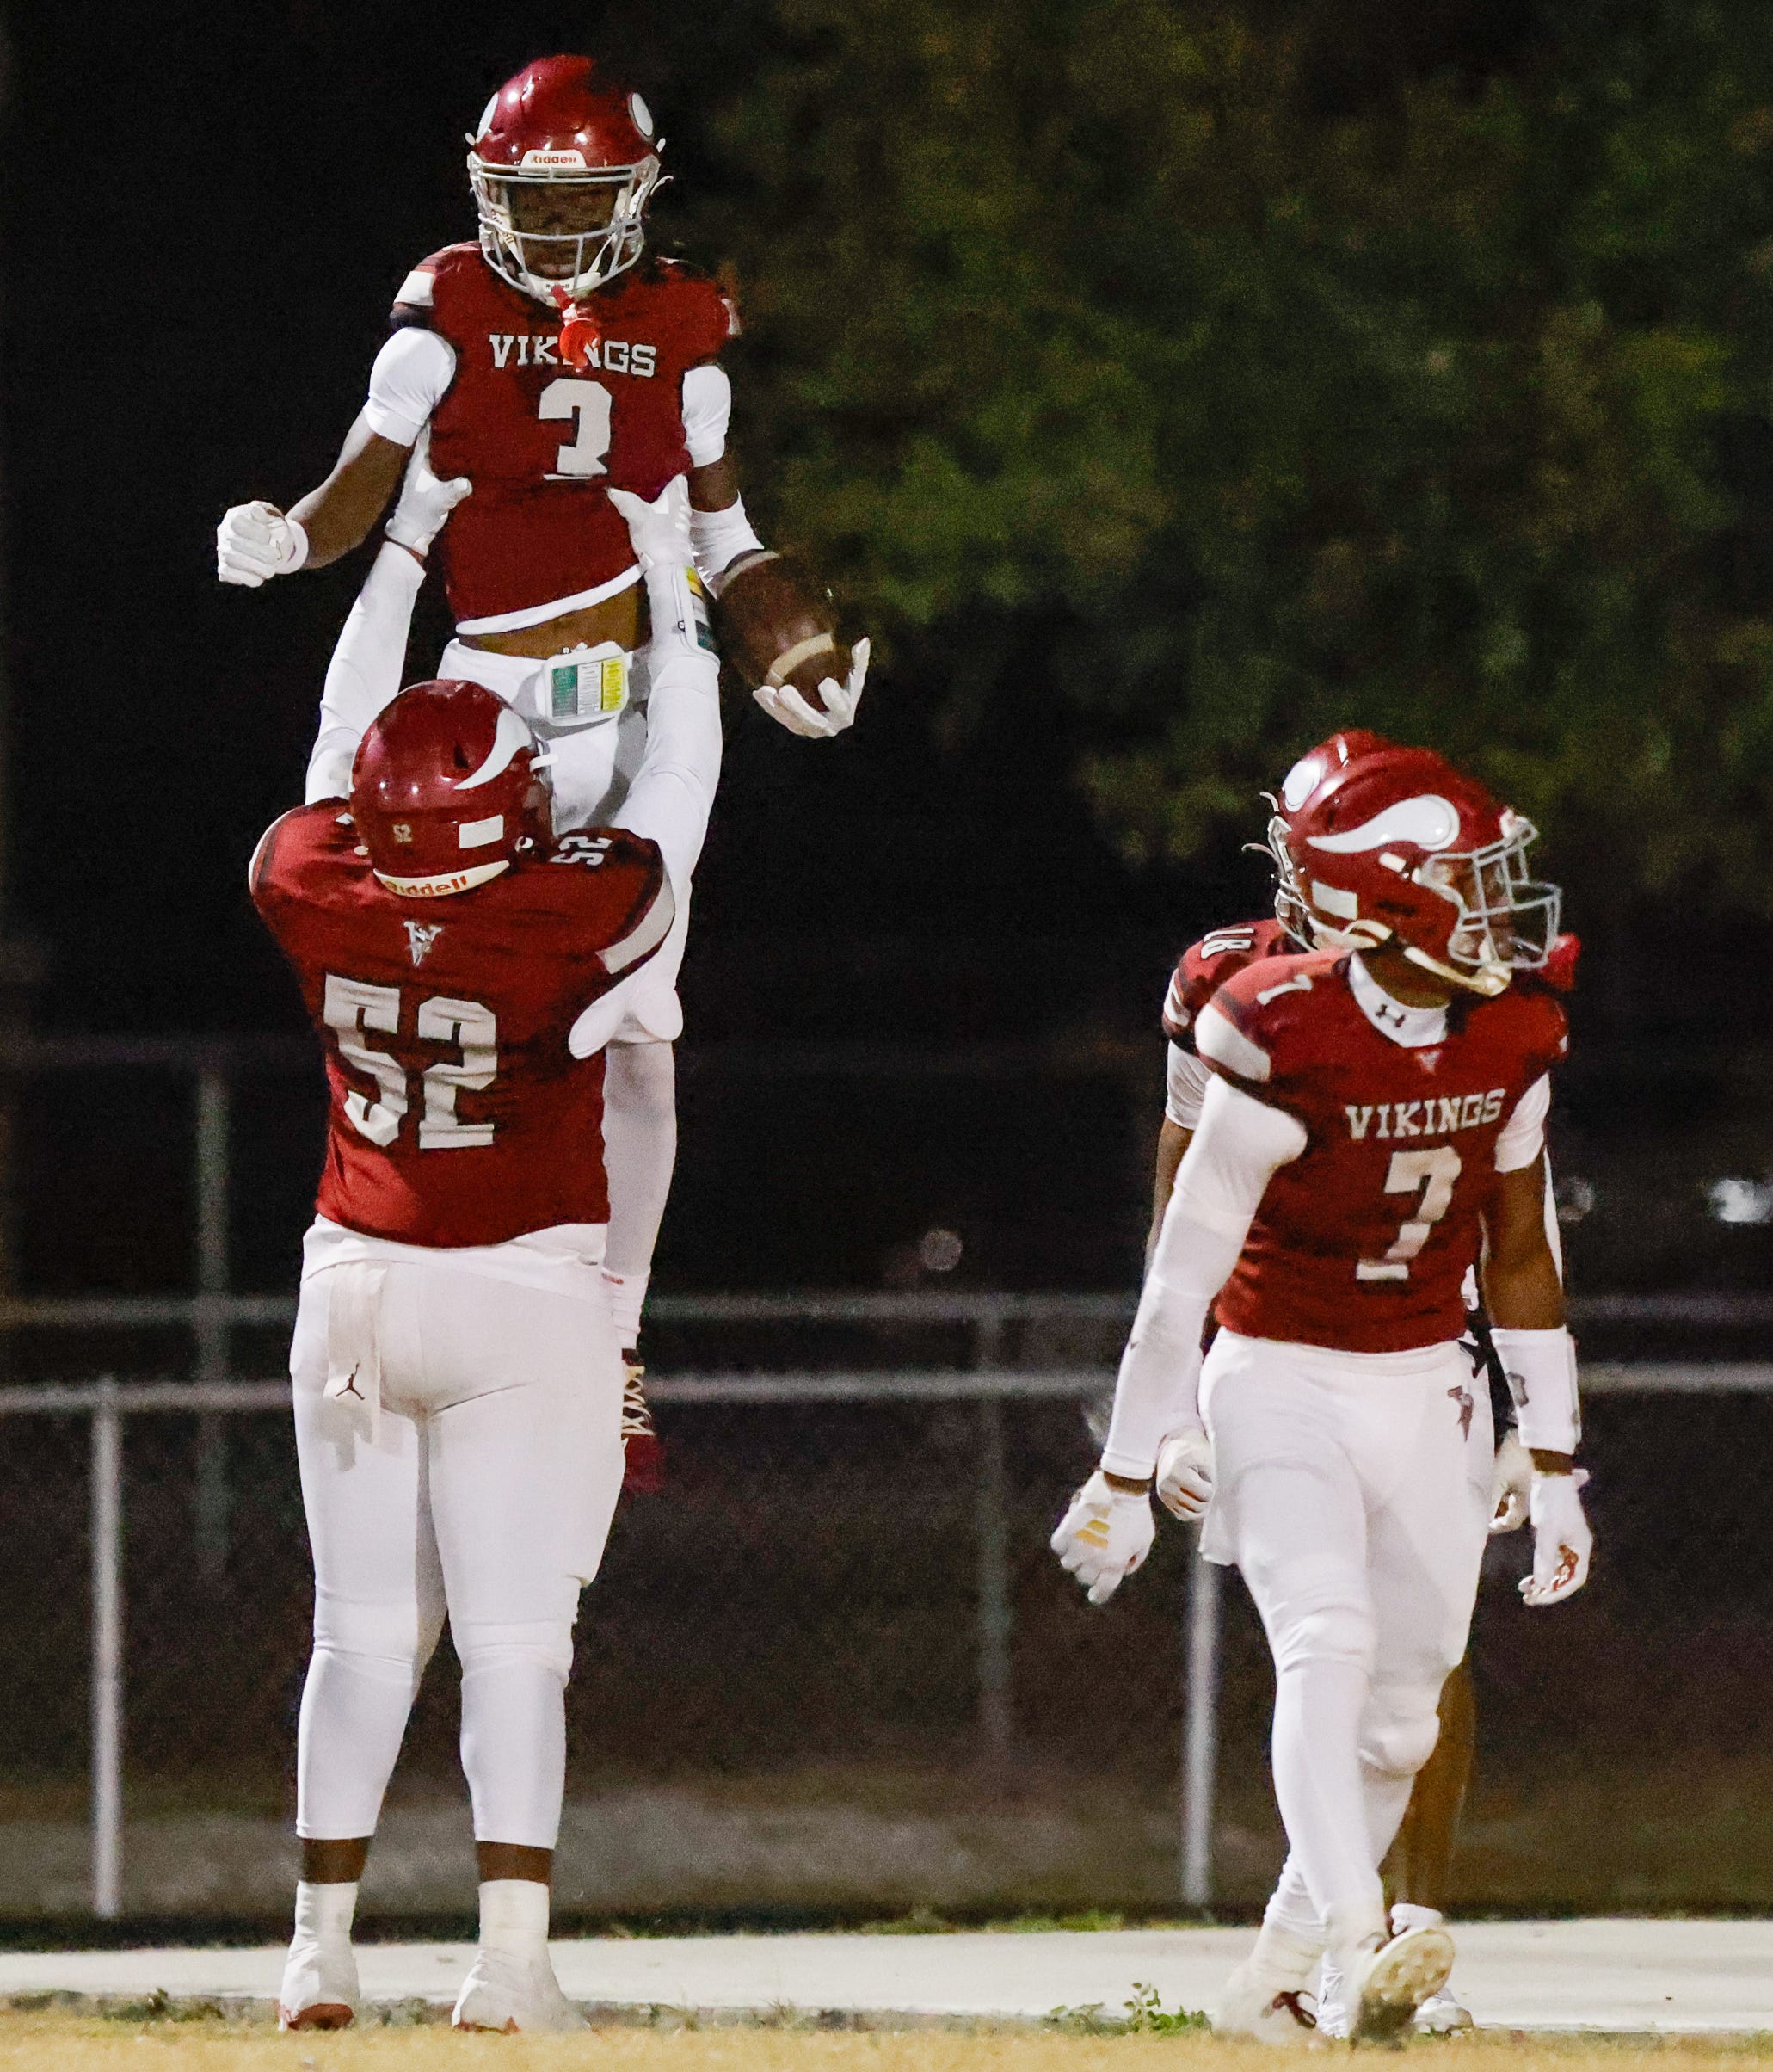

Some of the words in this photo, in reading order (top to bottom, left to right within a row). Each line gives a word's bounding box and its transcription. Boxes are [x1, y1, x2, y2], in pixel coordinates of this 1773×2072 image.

[489, 334, 657, 378] VIKNGS
[323, 971, 496, 1149] 52
[1345, 1088, 1506, 1141] VIKINGS
[1356, 1145, 1462, 1280] 7
